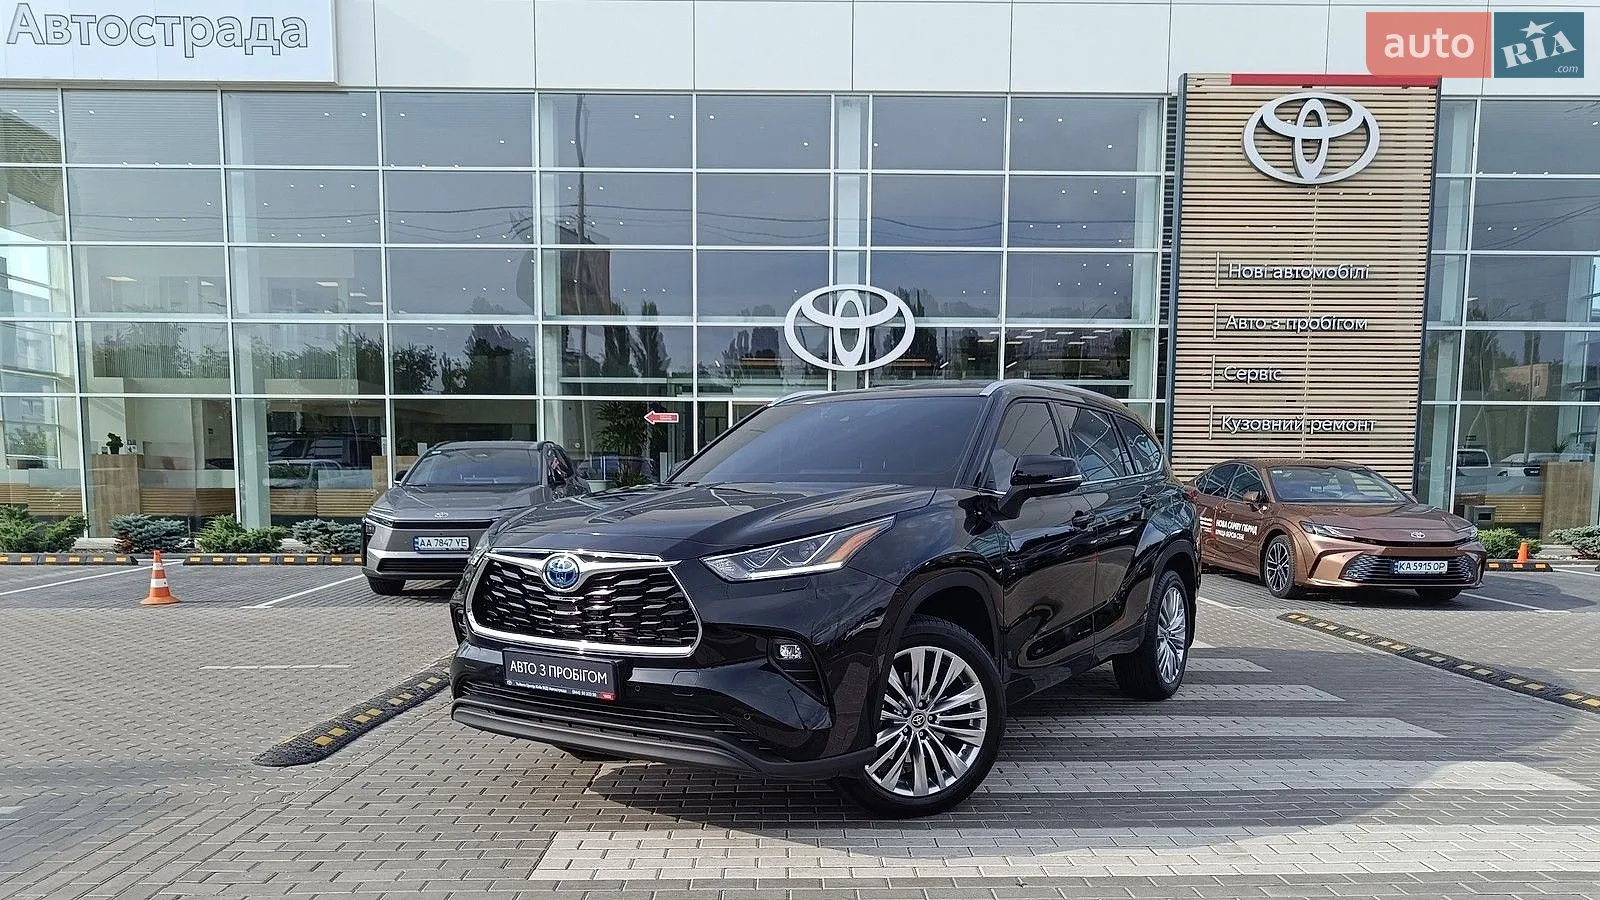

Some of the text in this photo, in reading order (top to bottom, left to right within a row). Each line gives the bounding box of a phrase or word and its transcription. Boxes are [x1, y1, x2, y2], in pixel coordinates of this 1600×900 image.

[6, 2, 309, 59] Автострада
[1227, 263, 1371, 280] Нові автомобілі
[1225, 315, 1369, 334] Авто з пробігом
[1223, 366, 1284, 385] Сервіс
[1220, 414, 1377, 435] Кузовний ремонт
[434, 539, 453, 547] 7847
[1413, 562, 1432, 571] 5915
[510, 660, 608, 685] АВТО З ПРОБІГОМ
